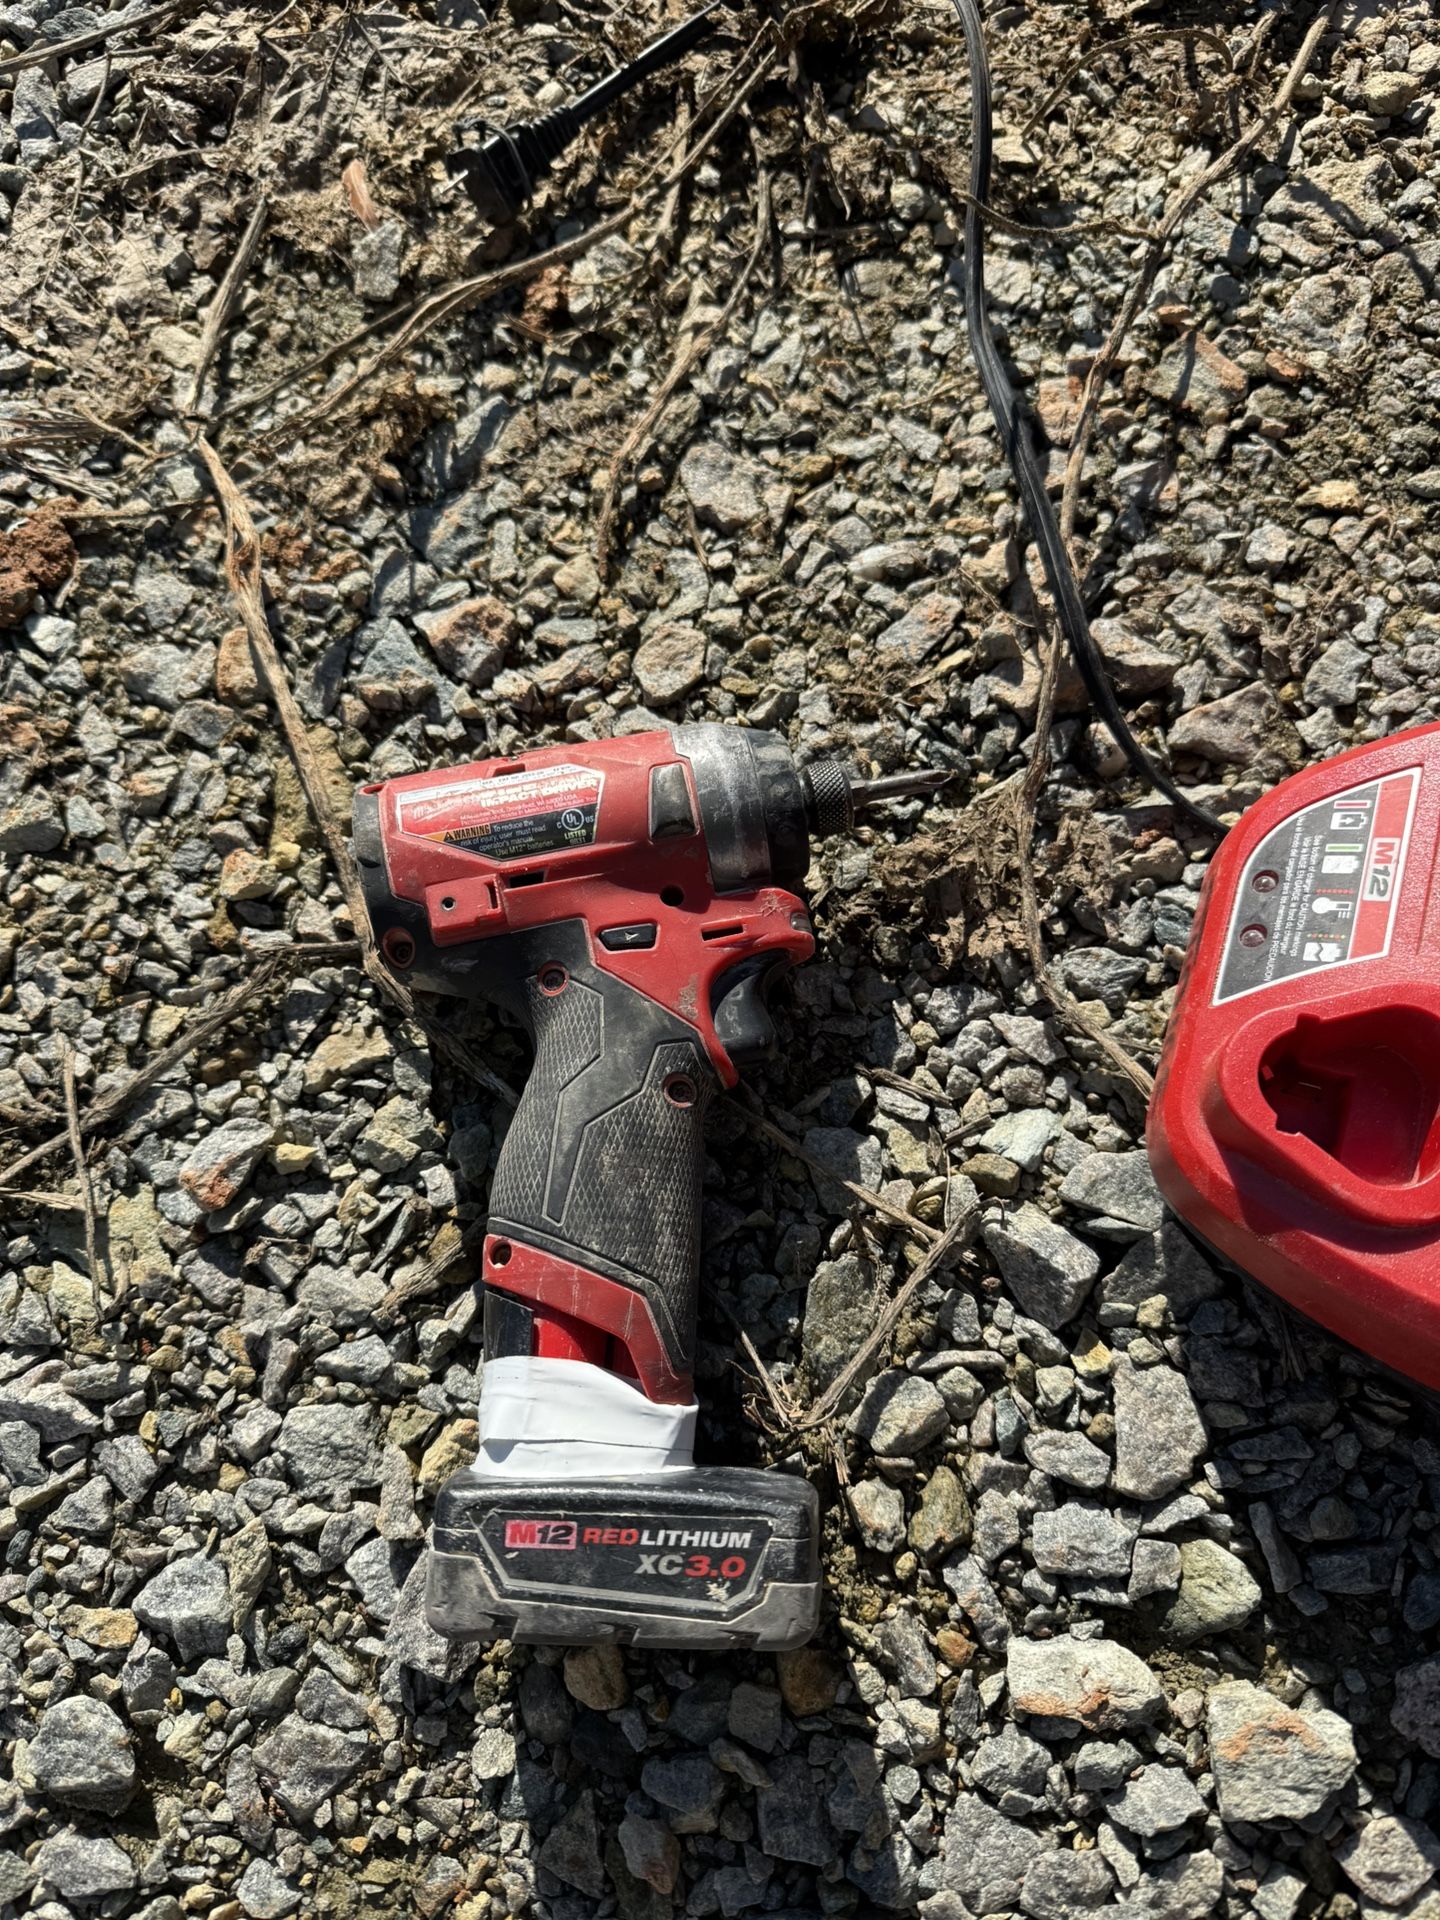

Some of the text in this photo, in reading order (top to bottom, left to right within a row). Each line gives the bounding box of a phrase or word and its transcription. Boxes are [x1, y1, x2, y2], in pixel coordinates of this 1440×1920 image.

[480, 787, 538, 807] IMPACT
[541, 777, 598, 797] DRIVER
[453, 819, 534, 841] WARNING To reduce the
[515, 828, 531, 836] must
[531, 824, 546, 833] read
[564, 829, 587, 840] LISTED
[1368, 842, 1396, 897] M12
[1296, 902, 1309, 932] CAUTION
[508, 1522, 574, 1546] M12
